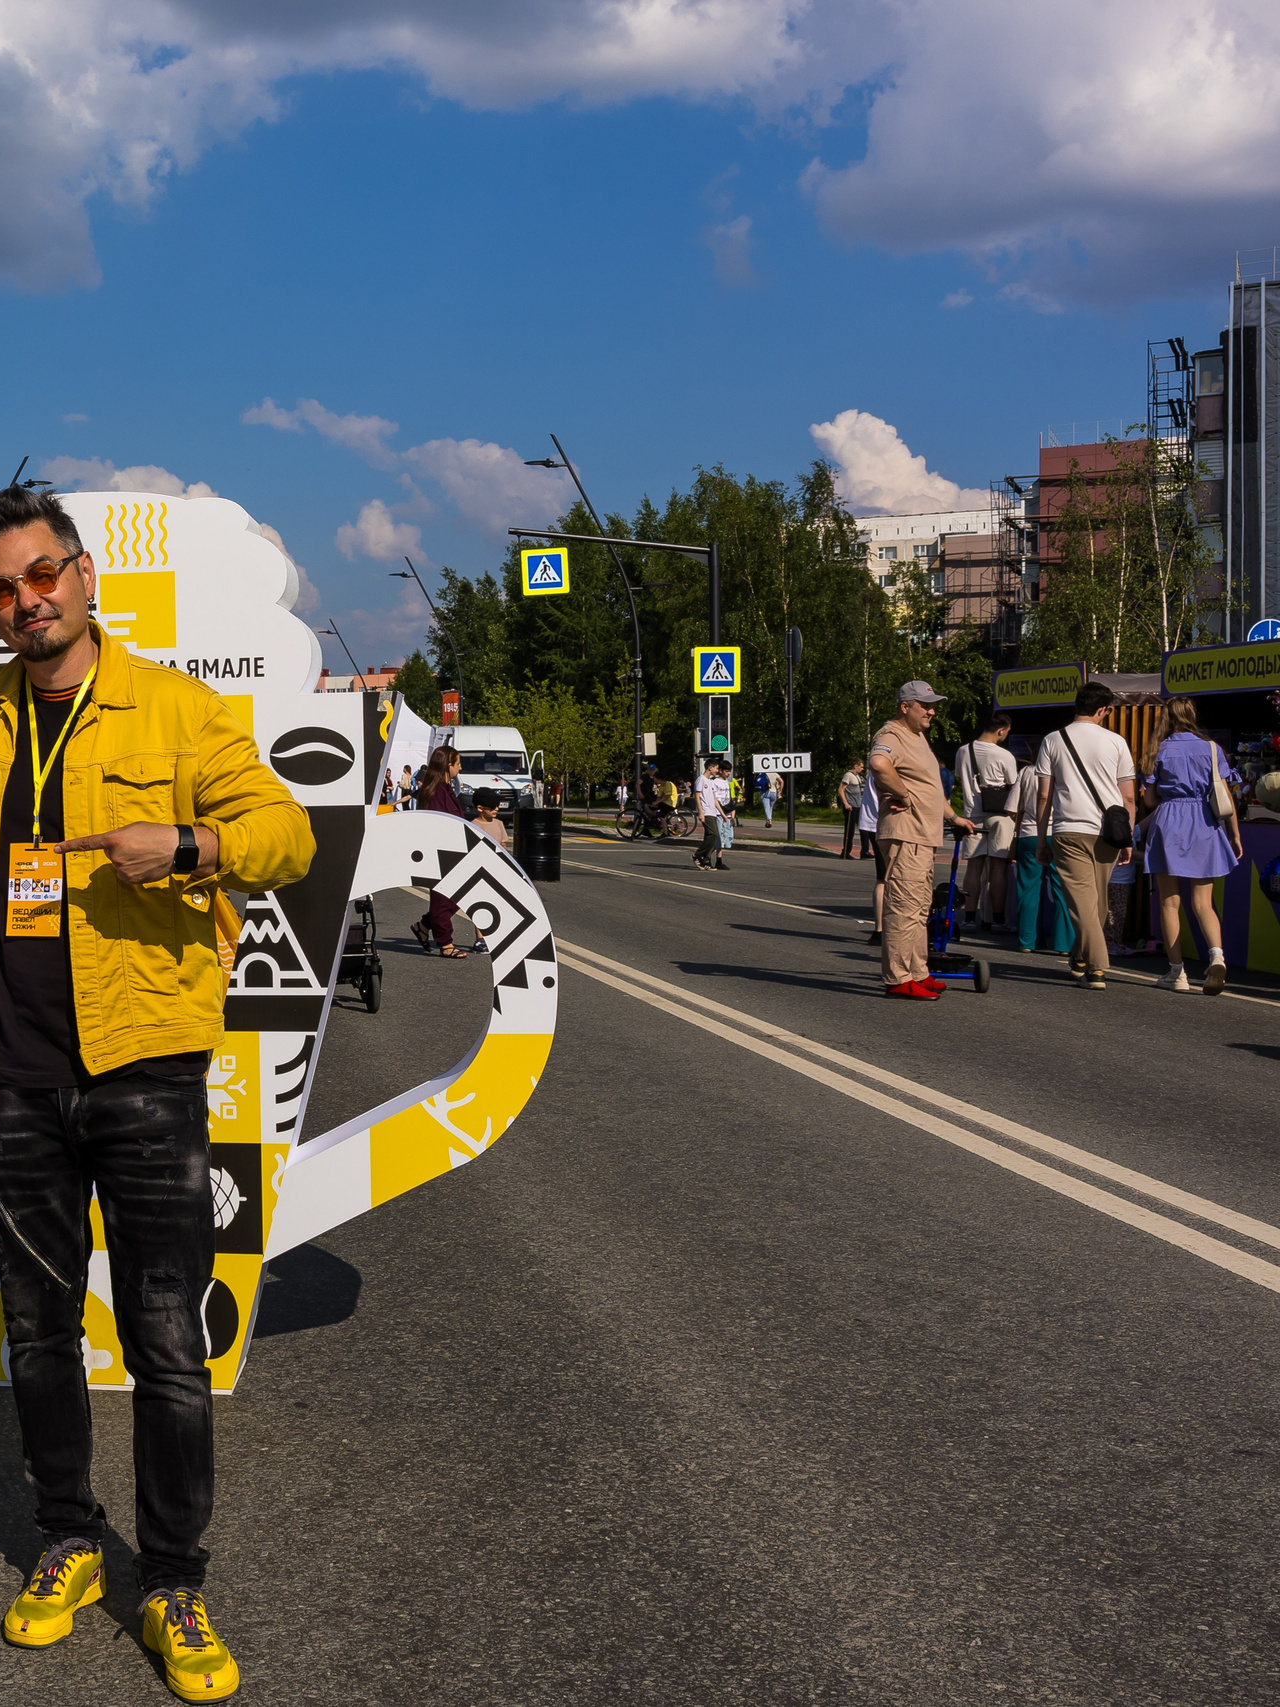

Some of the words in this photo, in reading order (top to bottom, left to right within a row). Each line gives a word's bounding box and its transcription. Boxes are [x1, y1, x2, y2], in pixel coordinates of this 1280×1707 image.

[186, 656, 265, 680] ЯМАЛЕ
[1168, 661, 1214, 683] МАРКЕТ
[998, 680, 1029, 697] МАРКЕТ
[1031, 676, 1078, 696] МОЛОДЫХ
[444, 703, 459, 712] 1945
[761, 756, 802, 769] СТОП
[13, 907, 52, 915] ВЕДУЩИЙ
